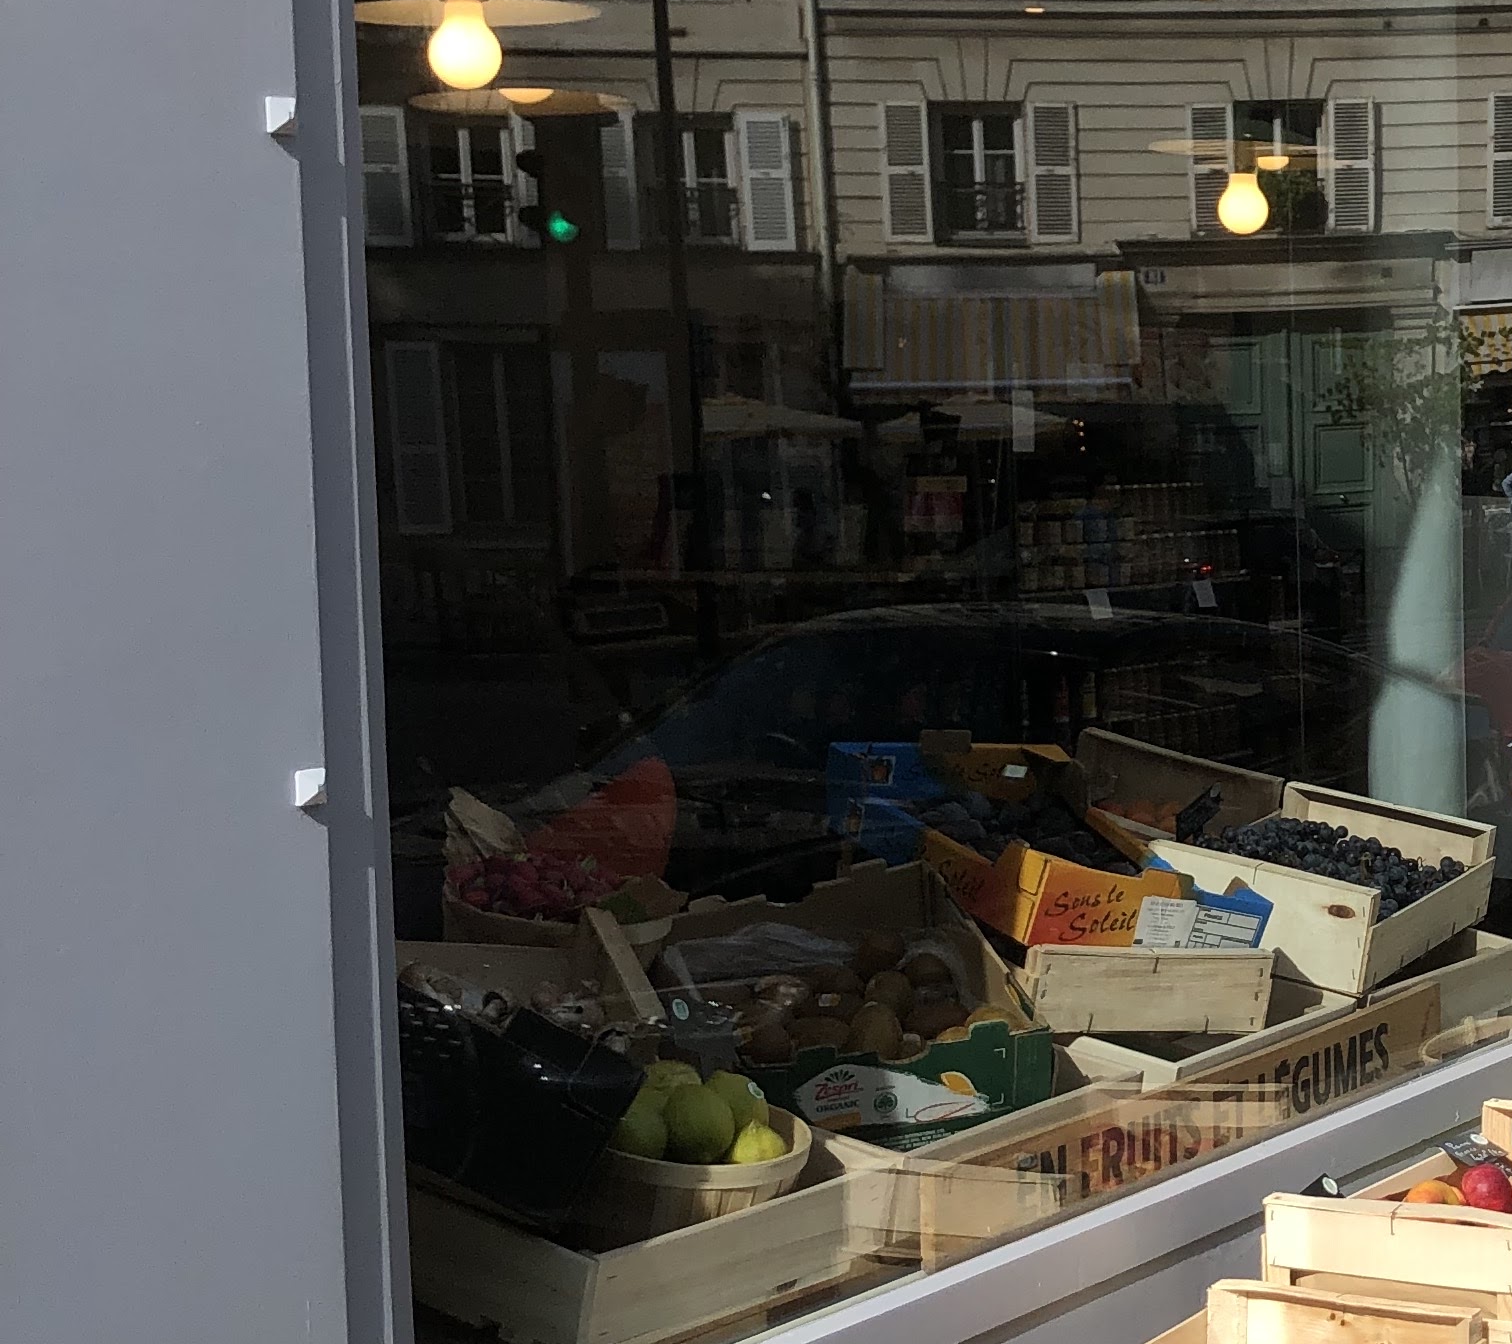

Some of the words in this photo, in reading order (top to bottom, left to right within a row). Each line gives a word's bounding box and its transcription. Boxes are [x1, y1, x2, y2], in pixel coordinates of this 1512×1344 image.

[1044, 890, 1101, 917] Sous
[1106, 883, 1126, 905] le
[1058, 908, 1138, 942] Soleil
[814, 1080, 861, 1102] Zespri
[815, 1098, 860, 1114] ORGANIC
[1080, 1109, 1202, 1199] FRUITS
[1212, 1080, 1250, 1149] ET
